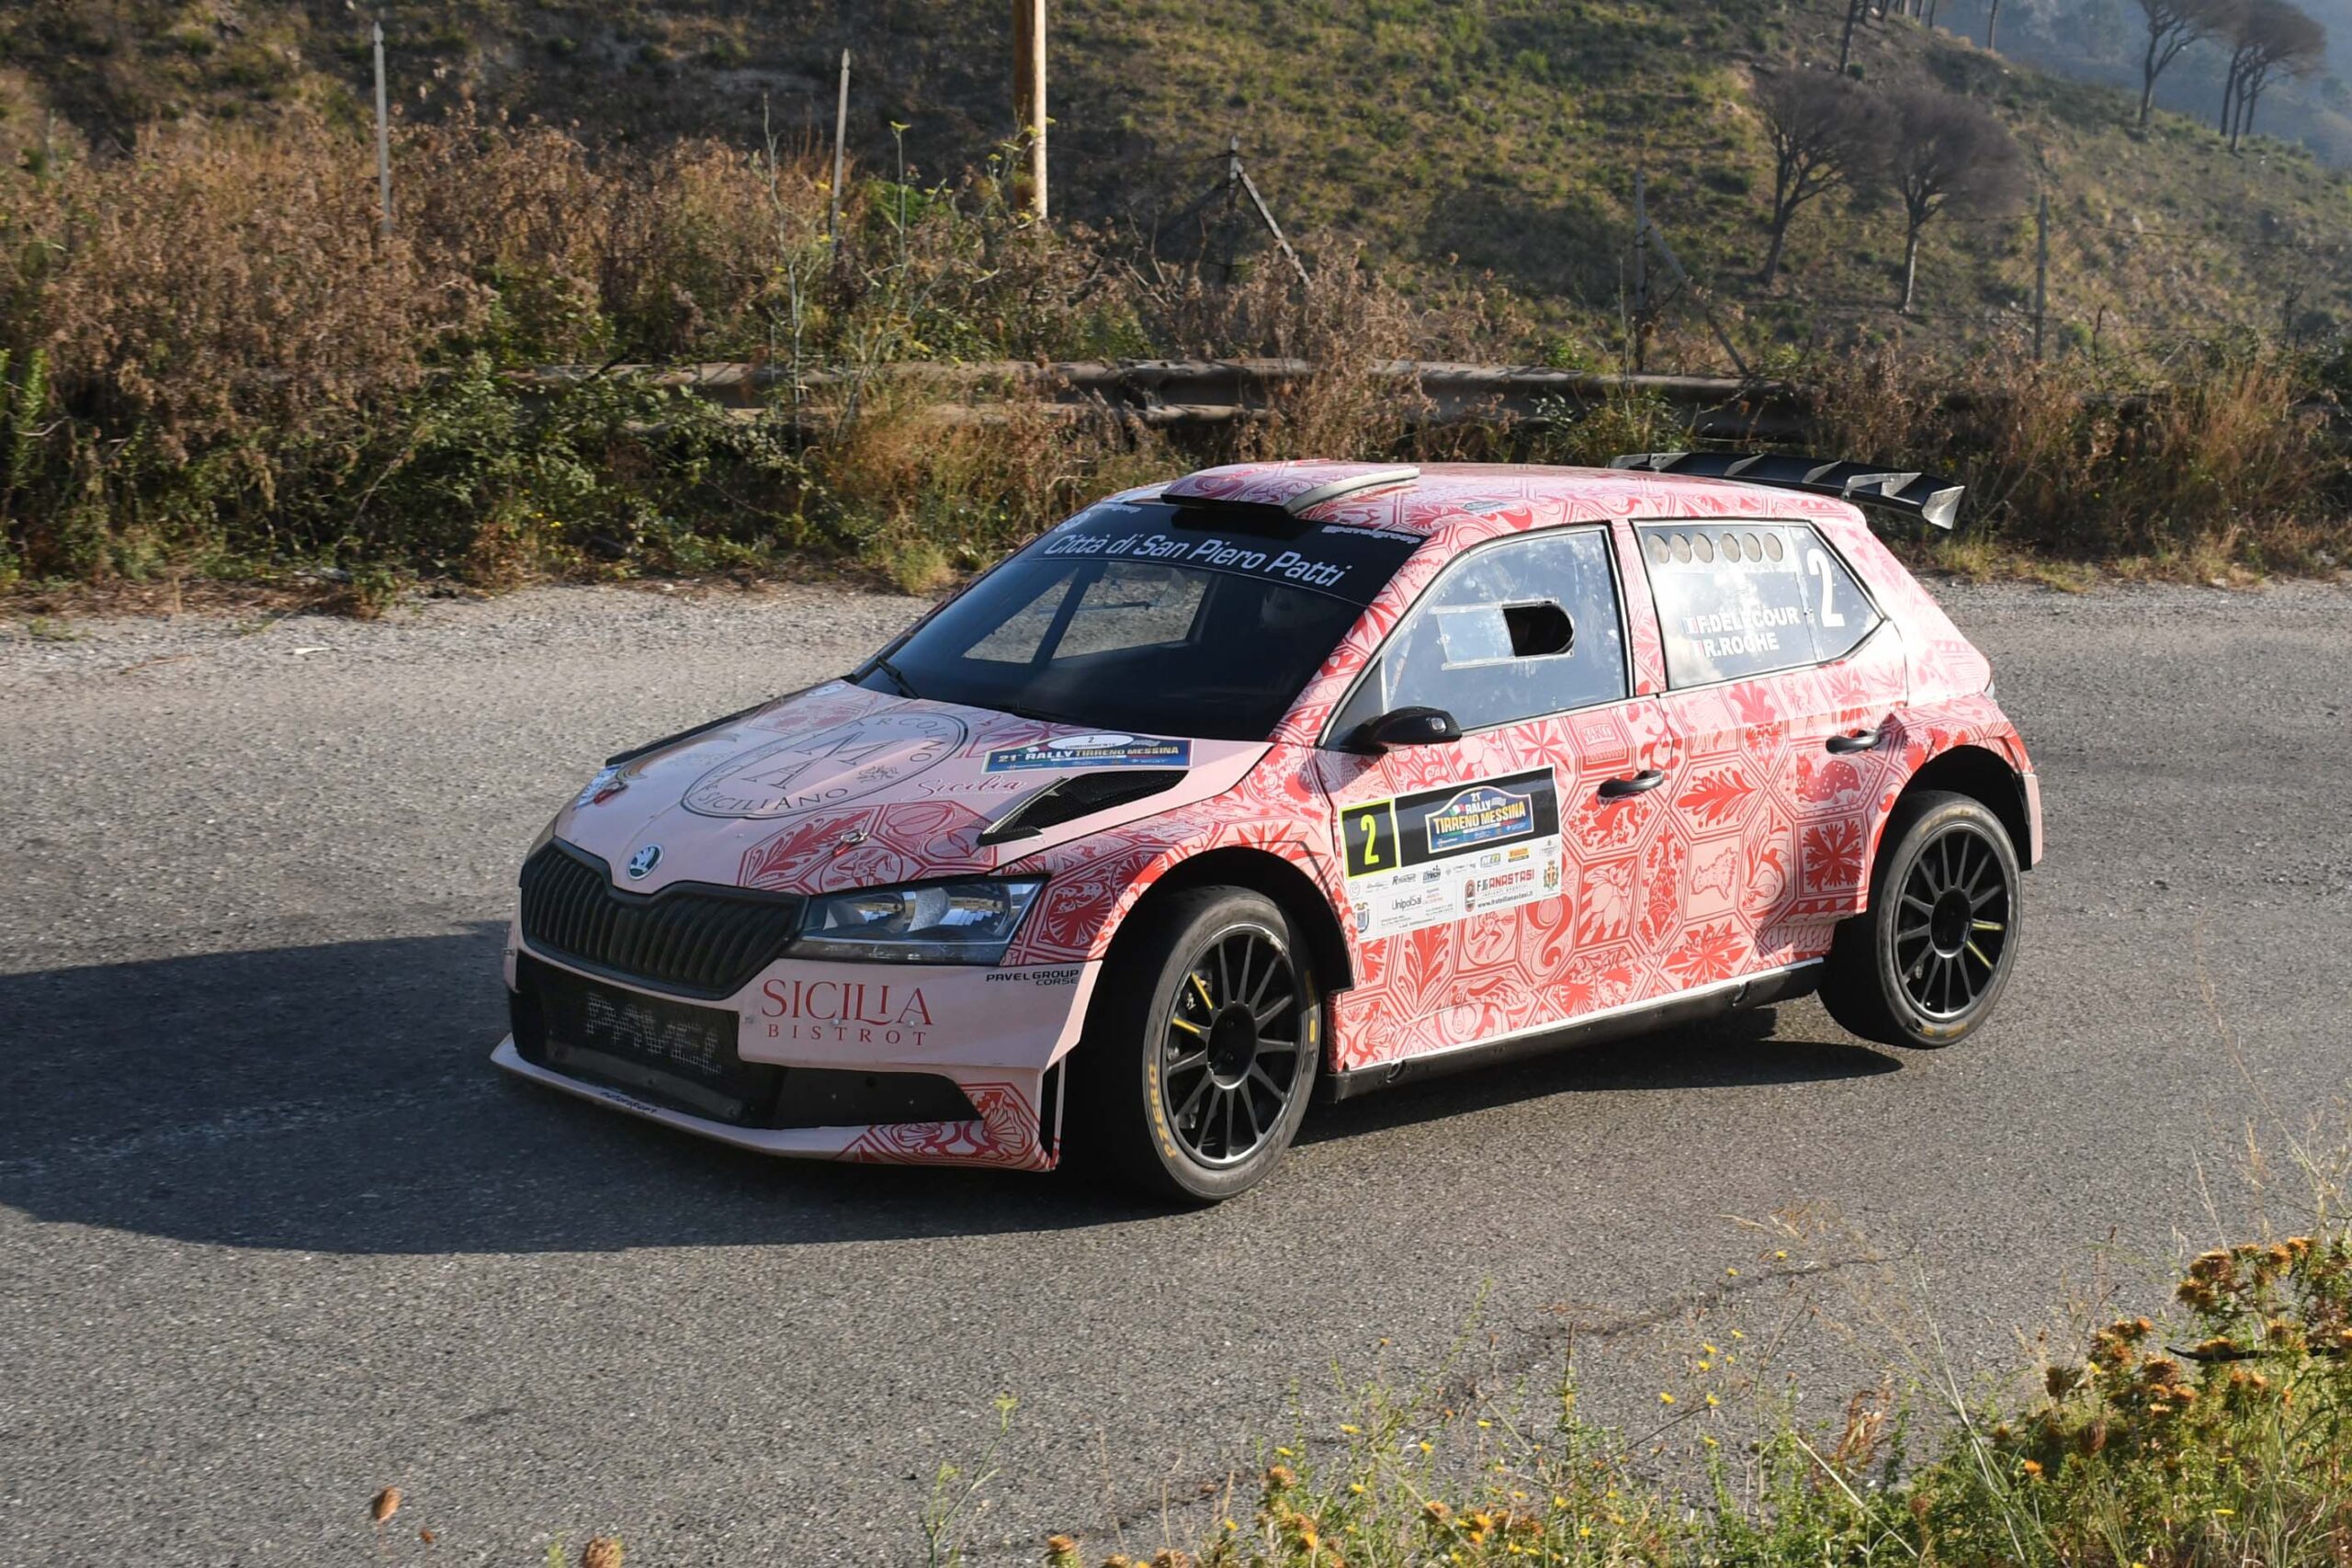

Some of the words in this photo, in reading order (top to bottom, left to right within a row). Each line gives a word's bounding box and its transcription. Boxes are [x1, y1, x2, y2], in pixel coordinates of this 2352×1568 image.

[1044, 534, 1111, 555] Città
[1105, 534, 1143, 554] di
[1133, 535, 1190, 559] San
[1186, 538, 1267, 570] Piero
[1264, 551, 1353, 587] Patti
[1806, 547, 1846, 628] 2
[1024, 750, 1074, 761] RALLY
[1075, 749, 1125, 757] TIRRENO
[1126, 746, 1180, 755] MESSINA
[697, 787, 848, 810] SICILIANO
[913, 774, 1024, 800] Sicilia
[1433, 813, 1480, 834] TIRRENO
[1480, 800, 1526, 825] MESSINA
[1464, 799, 1492, 815] RALLY
[1360, 813, 1380, 865] 2
[1488, 868, 1535, 889] ANASTASI
[1391, 894, 1422, 911] UnipolSai
[1035, 976, 1080, 986] CORSE
[761, 978, 934, 1026] SICILIA
[585, 991, 722, 1076] PAVEL
[768, 1023, 927, 1046] BISTROT
